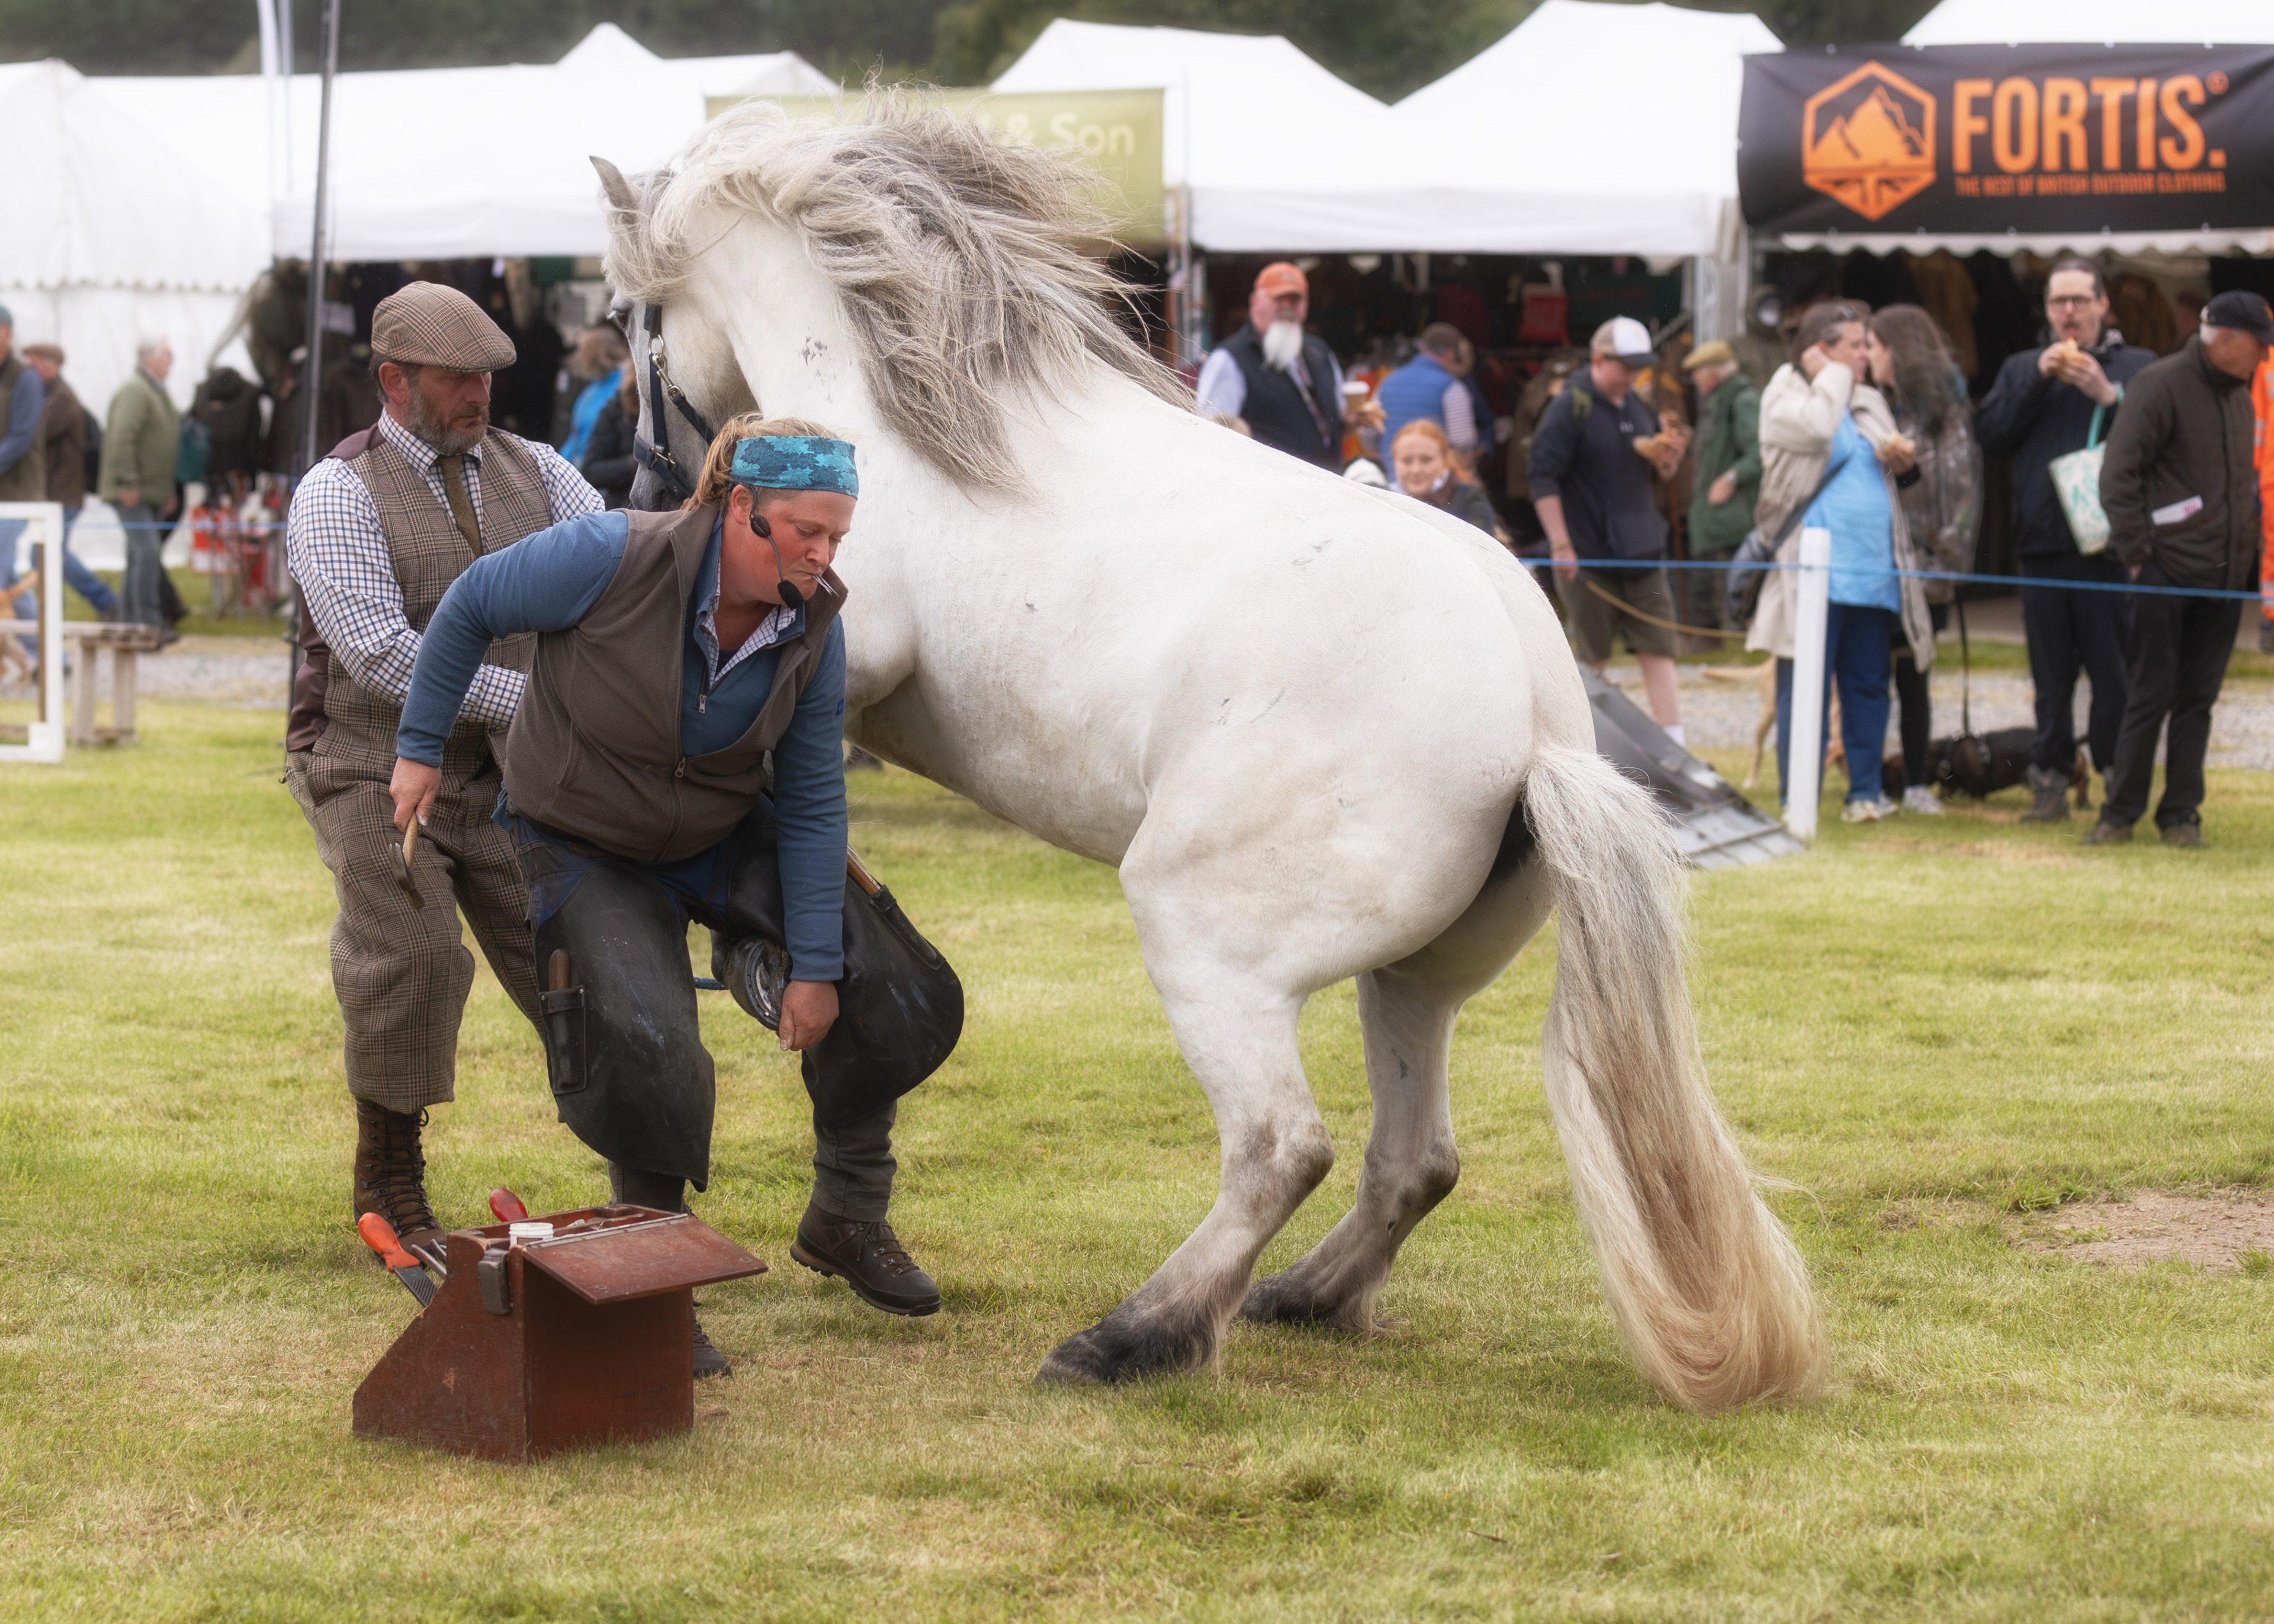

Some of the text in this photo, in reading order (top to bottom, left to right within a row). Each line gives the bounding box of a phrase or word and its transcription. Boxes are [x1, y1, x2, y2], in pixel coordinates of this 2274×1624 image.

[1051, 111, 1136, 155] Son
[1955, 175, 1980, 197] THE
[2016, 174, 2034, 196] OF
[2036, 173, 2090, 196] BRITISH
[2091, 172, 2155, 195] OUTDOOR
[2156, 171, 2227, 194] CLOTHING
